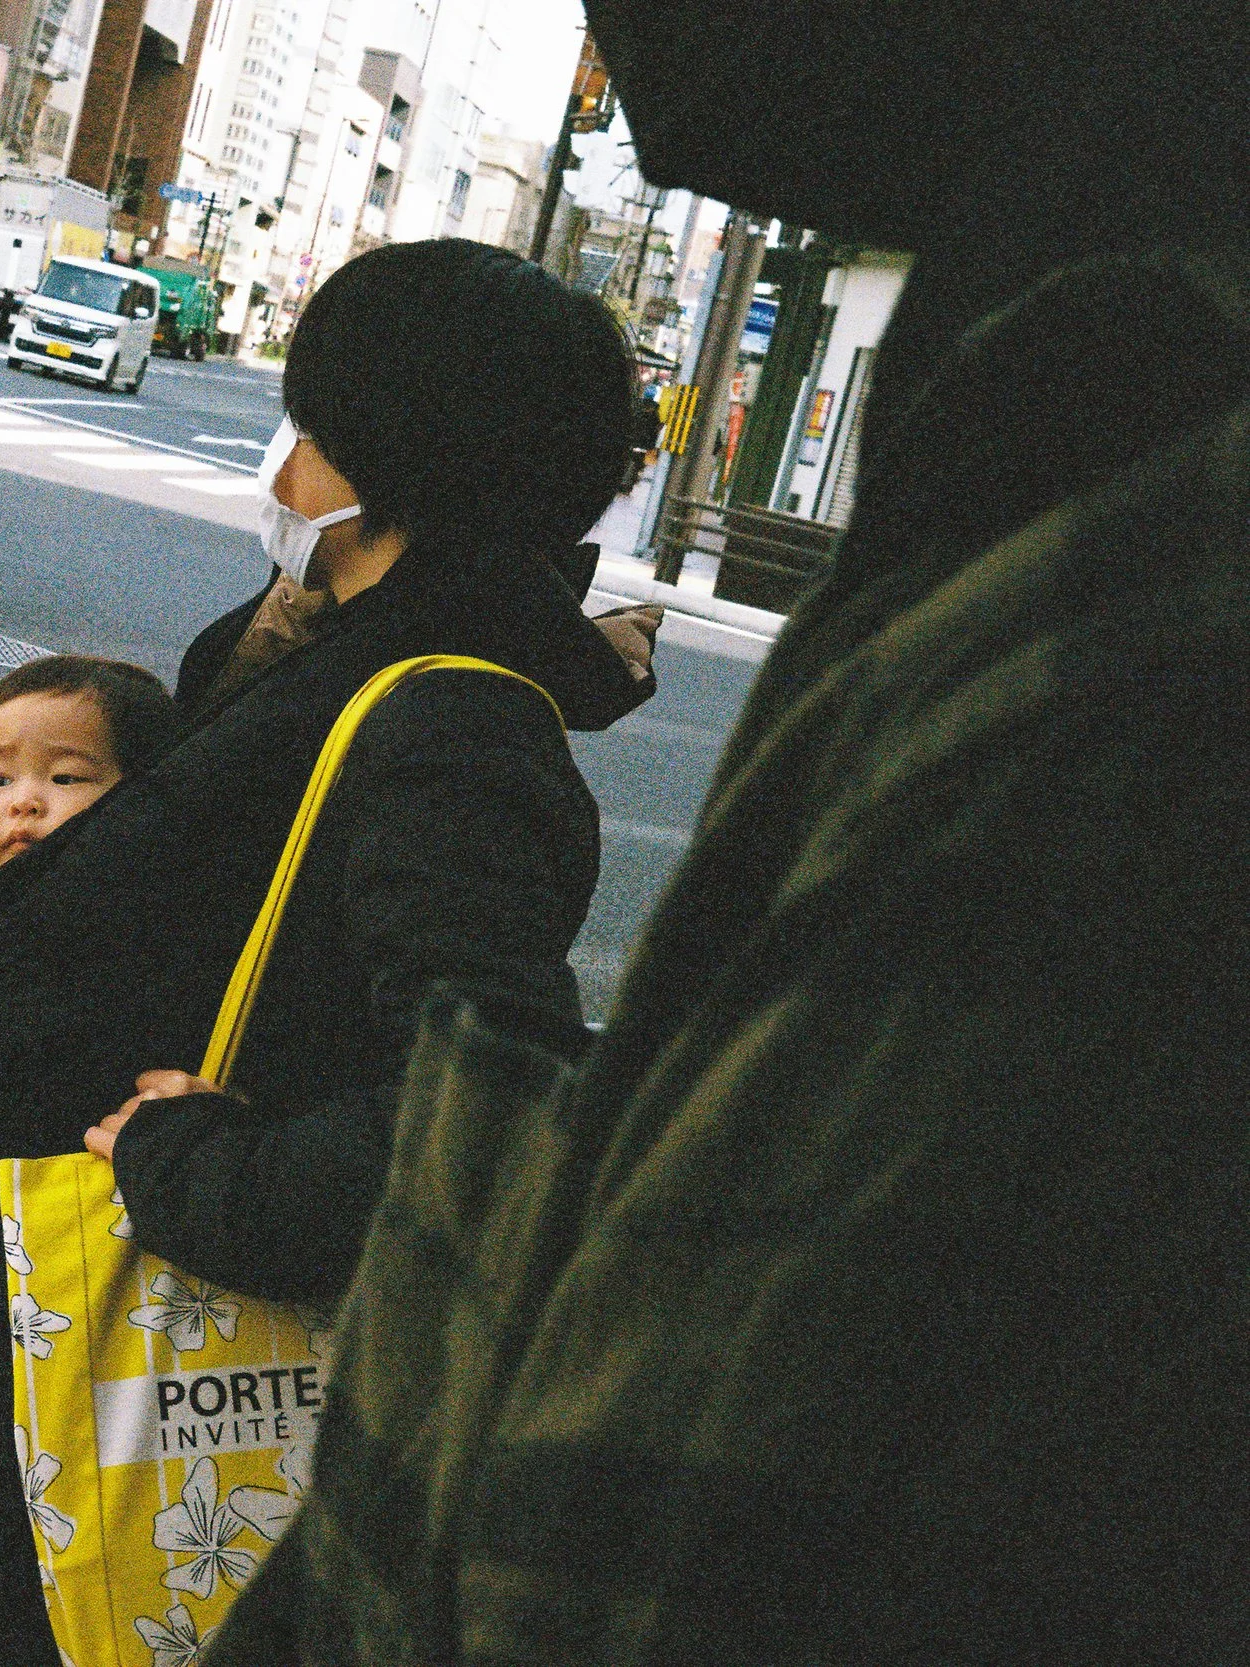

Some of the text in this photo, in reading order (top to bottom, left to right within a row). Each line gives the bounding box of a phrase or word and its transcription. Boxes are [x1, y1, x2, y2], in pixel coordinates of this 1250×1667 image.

[4, 207, 48, 226] サカイ
[161, 1411, 290, 1451] INVITÉ
